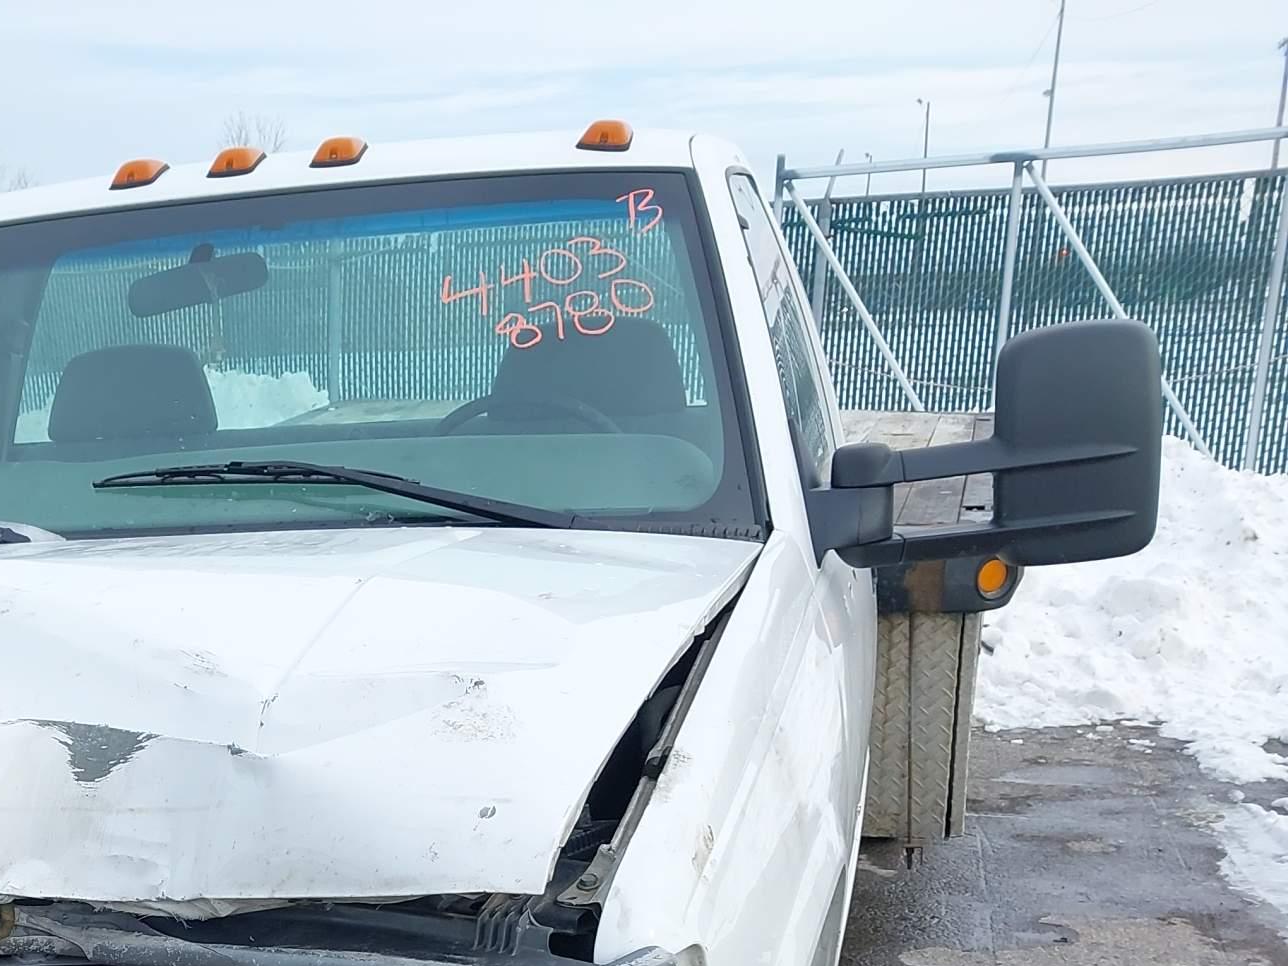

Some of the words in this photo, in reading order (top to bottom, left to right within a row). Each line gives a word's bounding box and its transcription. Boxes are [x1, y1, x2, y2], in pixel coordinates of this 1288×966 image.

[615, 187, 663, 238] B
[439, 235, 628, 317] 4403
[494, 278, 655, 350] 8780
